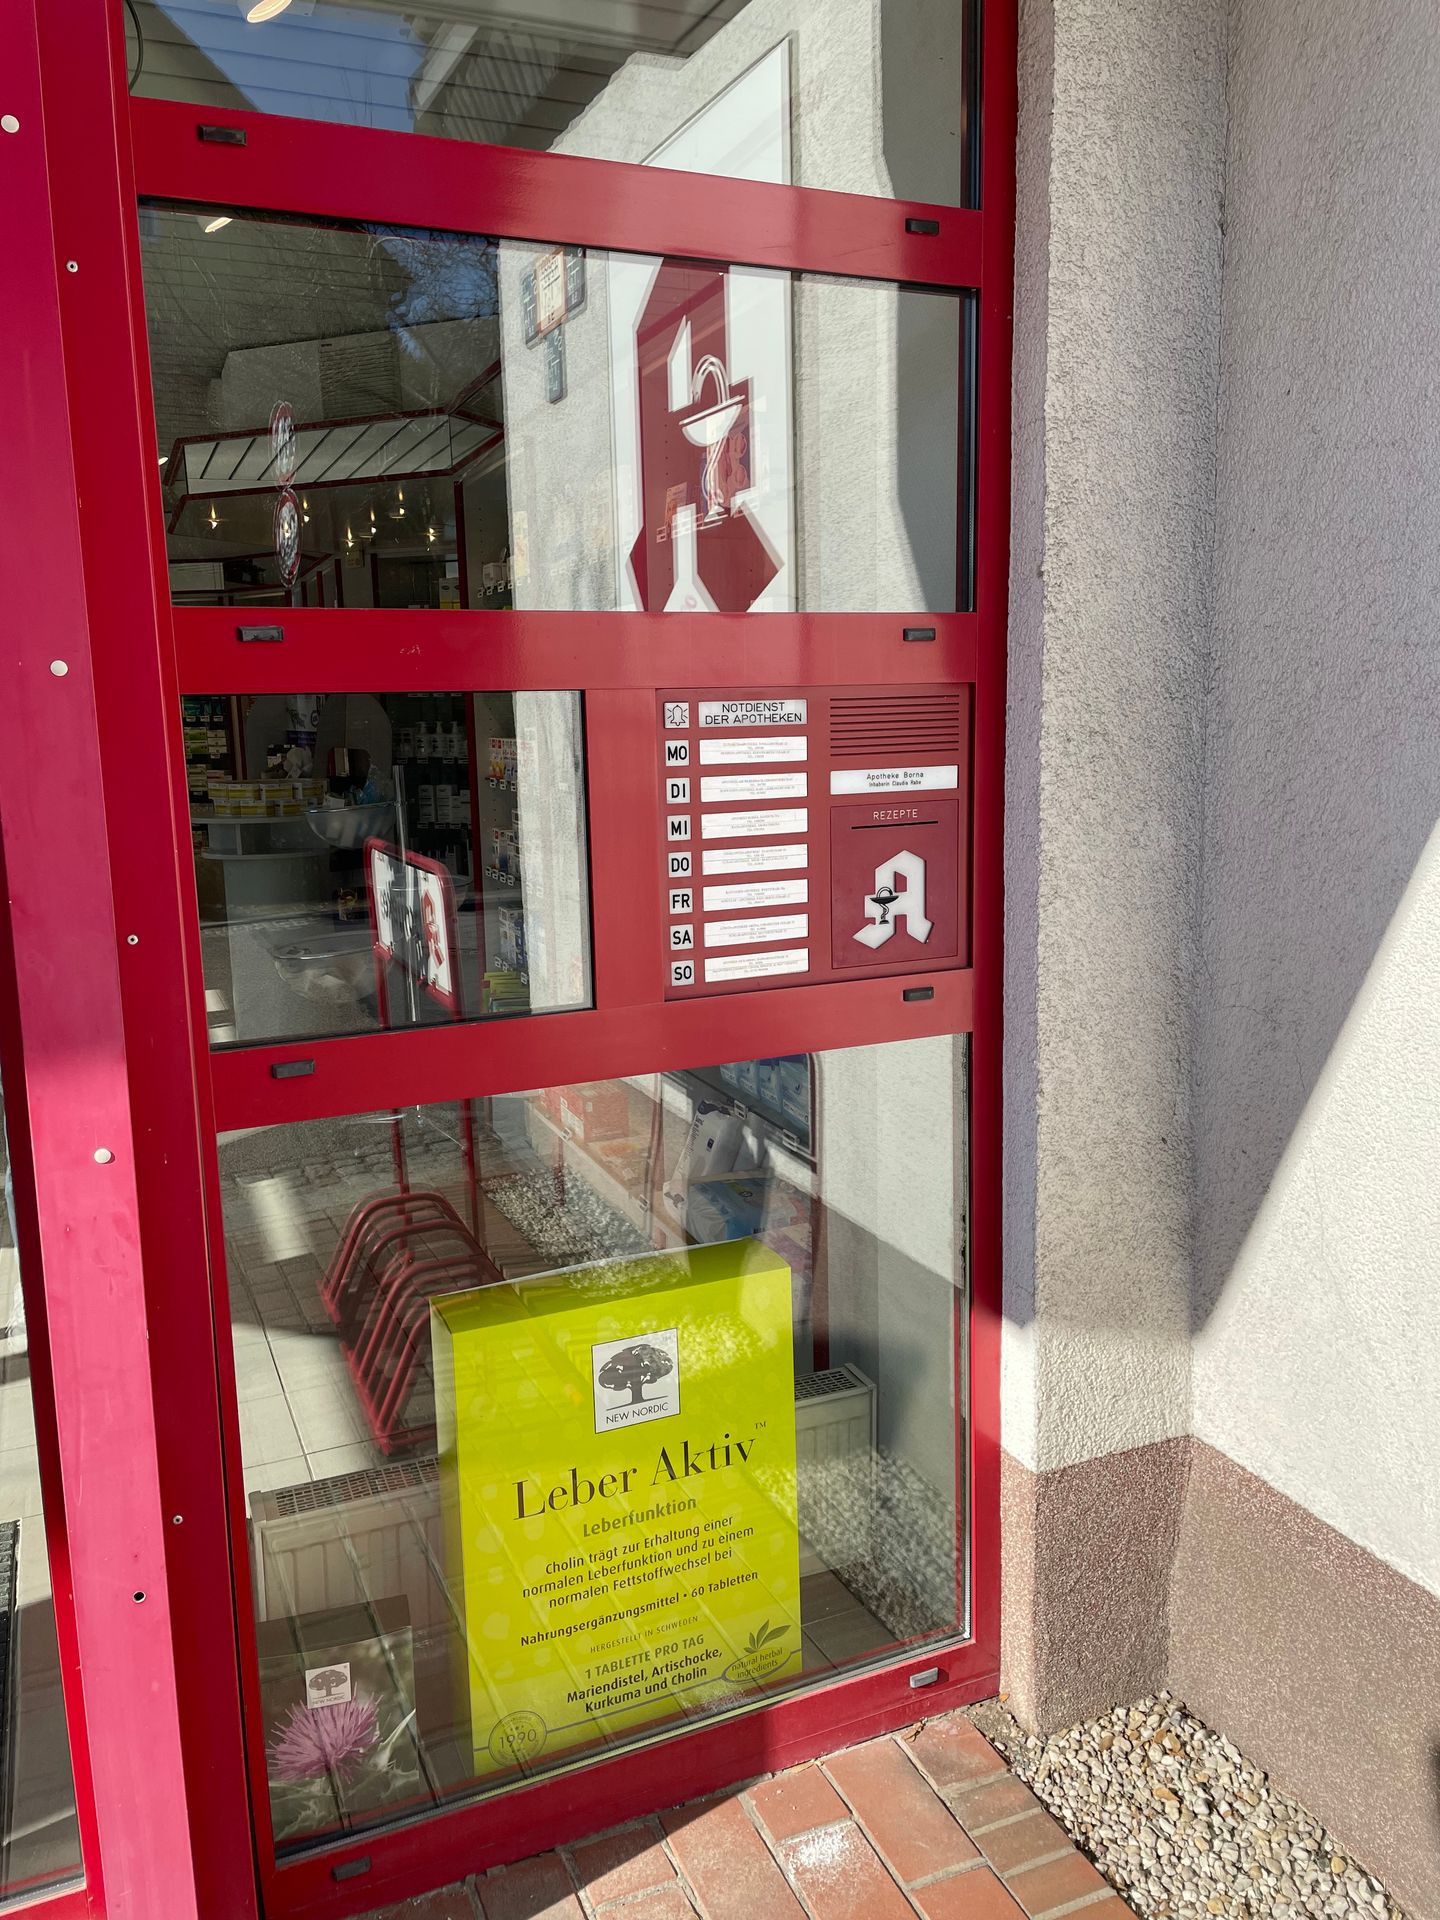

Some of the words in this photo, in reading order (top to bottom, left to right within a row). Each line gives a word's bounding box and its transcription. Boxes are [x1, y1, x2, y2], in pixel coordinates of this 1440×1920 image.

[722, 702, 785, 713] NOTDIENST
[705, 714, 730, 725] DER
[733, 712, 803, 724] APOTHEKEN
[667, 745, 688, 761] MO
[867, 772, 899, 780] Apotheke
[671, 783, 686, 799] DI
[873, 809, 918, 821] REZEPTE
[671, 820, 688, 836] MI
[671, 857, 690, 873] DO
[672, 894, 691, 910] FR
[673, 931, 692, 945] SA
[674, 966, 692, 980] SO
[606, 1410, 630, 1425] NEW
[632, 1402, 669, 1418] NORDIC
[512, 1468, 638, 1521] Leber
[583, 1496, 698, 1538] Leberfunktion
[545, 1556, 585, 1575] Cholin
[589, 1546, 619, 1567] trägt
[622, 1540, 641, 1556] zur
[644, 1524, 700, 1550] Erhaltung
[703, 1515, 734, 1533] einer
[522, 1572, 584, 1599] normalen
[588, 1551, 673, 1581] Leberfunktion
[676, 1542, 698, 1559] und
[702, 1538, 715, 1551] zu
[718, 1526, 755, 1546] einem
[549, 1583, 610, 1609] normalen
[612, 1556, 711, 1591] Fettstoffwechsel
[714, 1547, 733, 1567] bei
[520, 1593, 681, 1647] Nahrungsergänzungsmittel
[691, 1586, 705, 1599] 60
[708, 1571, 759, 1595] Tabletten
[590, 1632, 642, 1654] HERGESTELLT
[644, 1629, 654, 1638] IN
[656, 1616, 699, 1635] SCHWEDEN
[584, 1669, 592, 1680] 1
[594, 1652, 652, 1678] TABLETTE
[654, 1642, 679, 1659] PRO
[682, 1634, 705, 1651] TAG
[732, 1657, 758, 1671] natural
[760, 1648, 783, 1662] herbal
[567, 1671, 649, 1704] Mariendistel,
[651, 1649, 723, 1679] Artischocke,
[738, 1660, 778, 1679] ingredients
[585, 1689, 642, 1714] Kurkuma
[645, 1676, 668, 1693] und
[672, 1666, 707, 1687] Cholin
[499, 1729, 537, 1749] 1990
